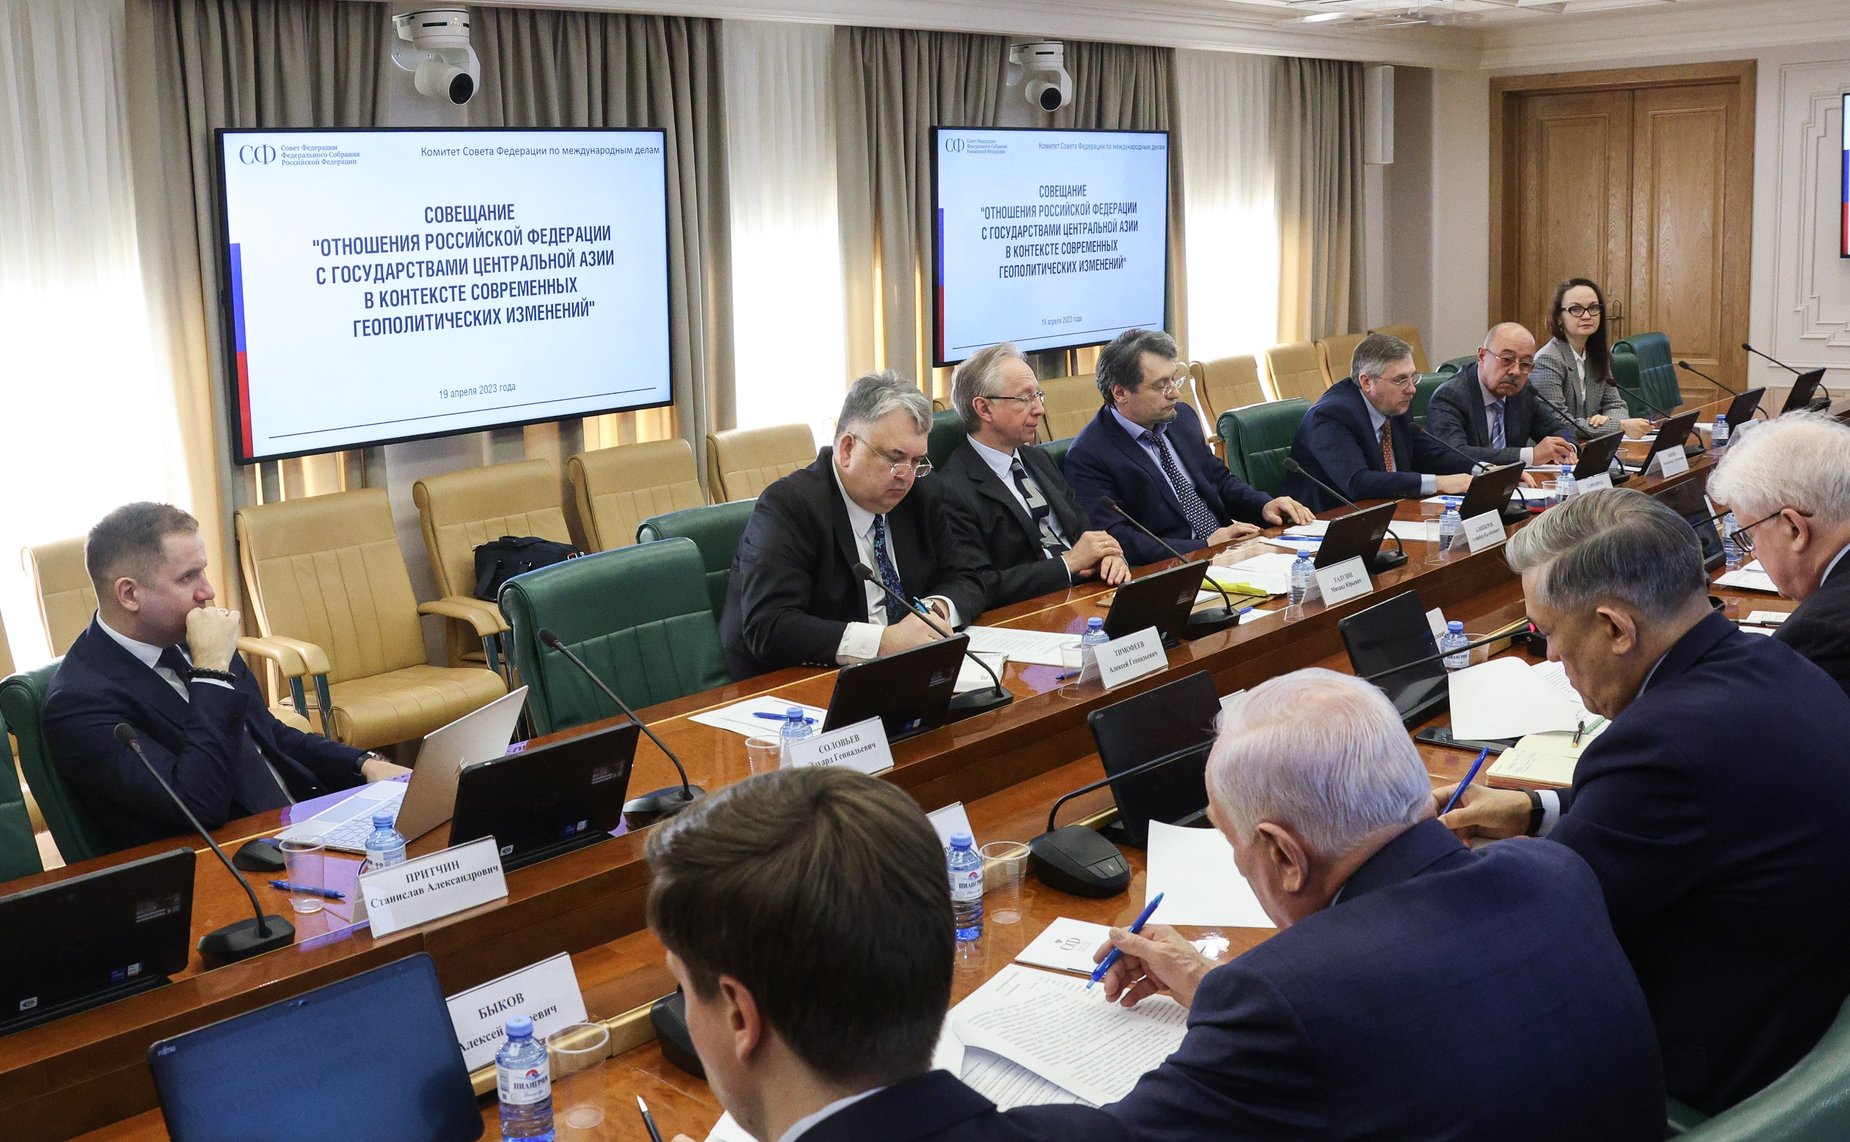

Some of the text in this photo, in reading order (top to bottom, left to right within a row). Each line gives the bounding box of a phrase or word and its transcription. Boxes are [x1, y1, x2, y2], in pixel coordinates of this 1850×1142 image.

[239, 144, 276, 165] СФ
[301, 144, 337, 152] Федерации
[420, 146, 660, 158] Комитет Совета Федерации по международным делам
[321, 158, 357, 166] Федерации
[1039, 184, 1087, 199] СОВЕЩАНИЕ
[425, 203, 515, 224] СОВЕЩАНИЕ
[980, 201, 1137, 220] "ОТНОШЕНИЯ РОССИЙСКОЙ ФЕДЕРАЦИИ
[981, 218, 1139, 240] С ГОСУДАРСТВАМИ ЦЕНТРАЛЬНОЙ АЗИИ
[313, 225, 611, 257] "ОТНОШЕНИЯ РОССИЙСКОЙ ФЕДЕРАЦИИ
[1005, 239, 1118, 259] В КОНТЕКСТЕ СОВРЕМЕННЫХ
[316, 248, 614, 285] С ГОСУДАРСТВАМИ ЦЕНТРАЛЬНОЙ АЗИИ
[999, 255, 1127, 279] ГЕОПОЛИТИЧЕСКИХ ИЗМЕНЕНИЙ"
[364, 277, 578, 309] В КОНТЕКСТЕ СОВРЕМЕННЫХ
[353, 297, 595, 338] ГЕОПОЛИТИЧЕСКИХ ИЗМЕНЕНИЙ"
[439, 383, 516, 399] 19 апреля 2023 года
[1114, 640, 1145, 657] ТИМОФЕЕВ
[818, 734, 861, 755] СОЛОВЬЕВ
[834, 742, 877, 762] Геннадьевич
[405, 860, 460, 884] ПРИТЧИН
[370, 865, 500, 909] Станислав Александрович
[478, 992, 525, 1020] БЫКОВ
